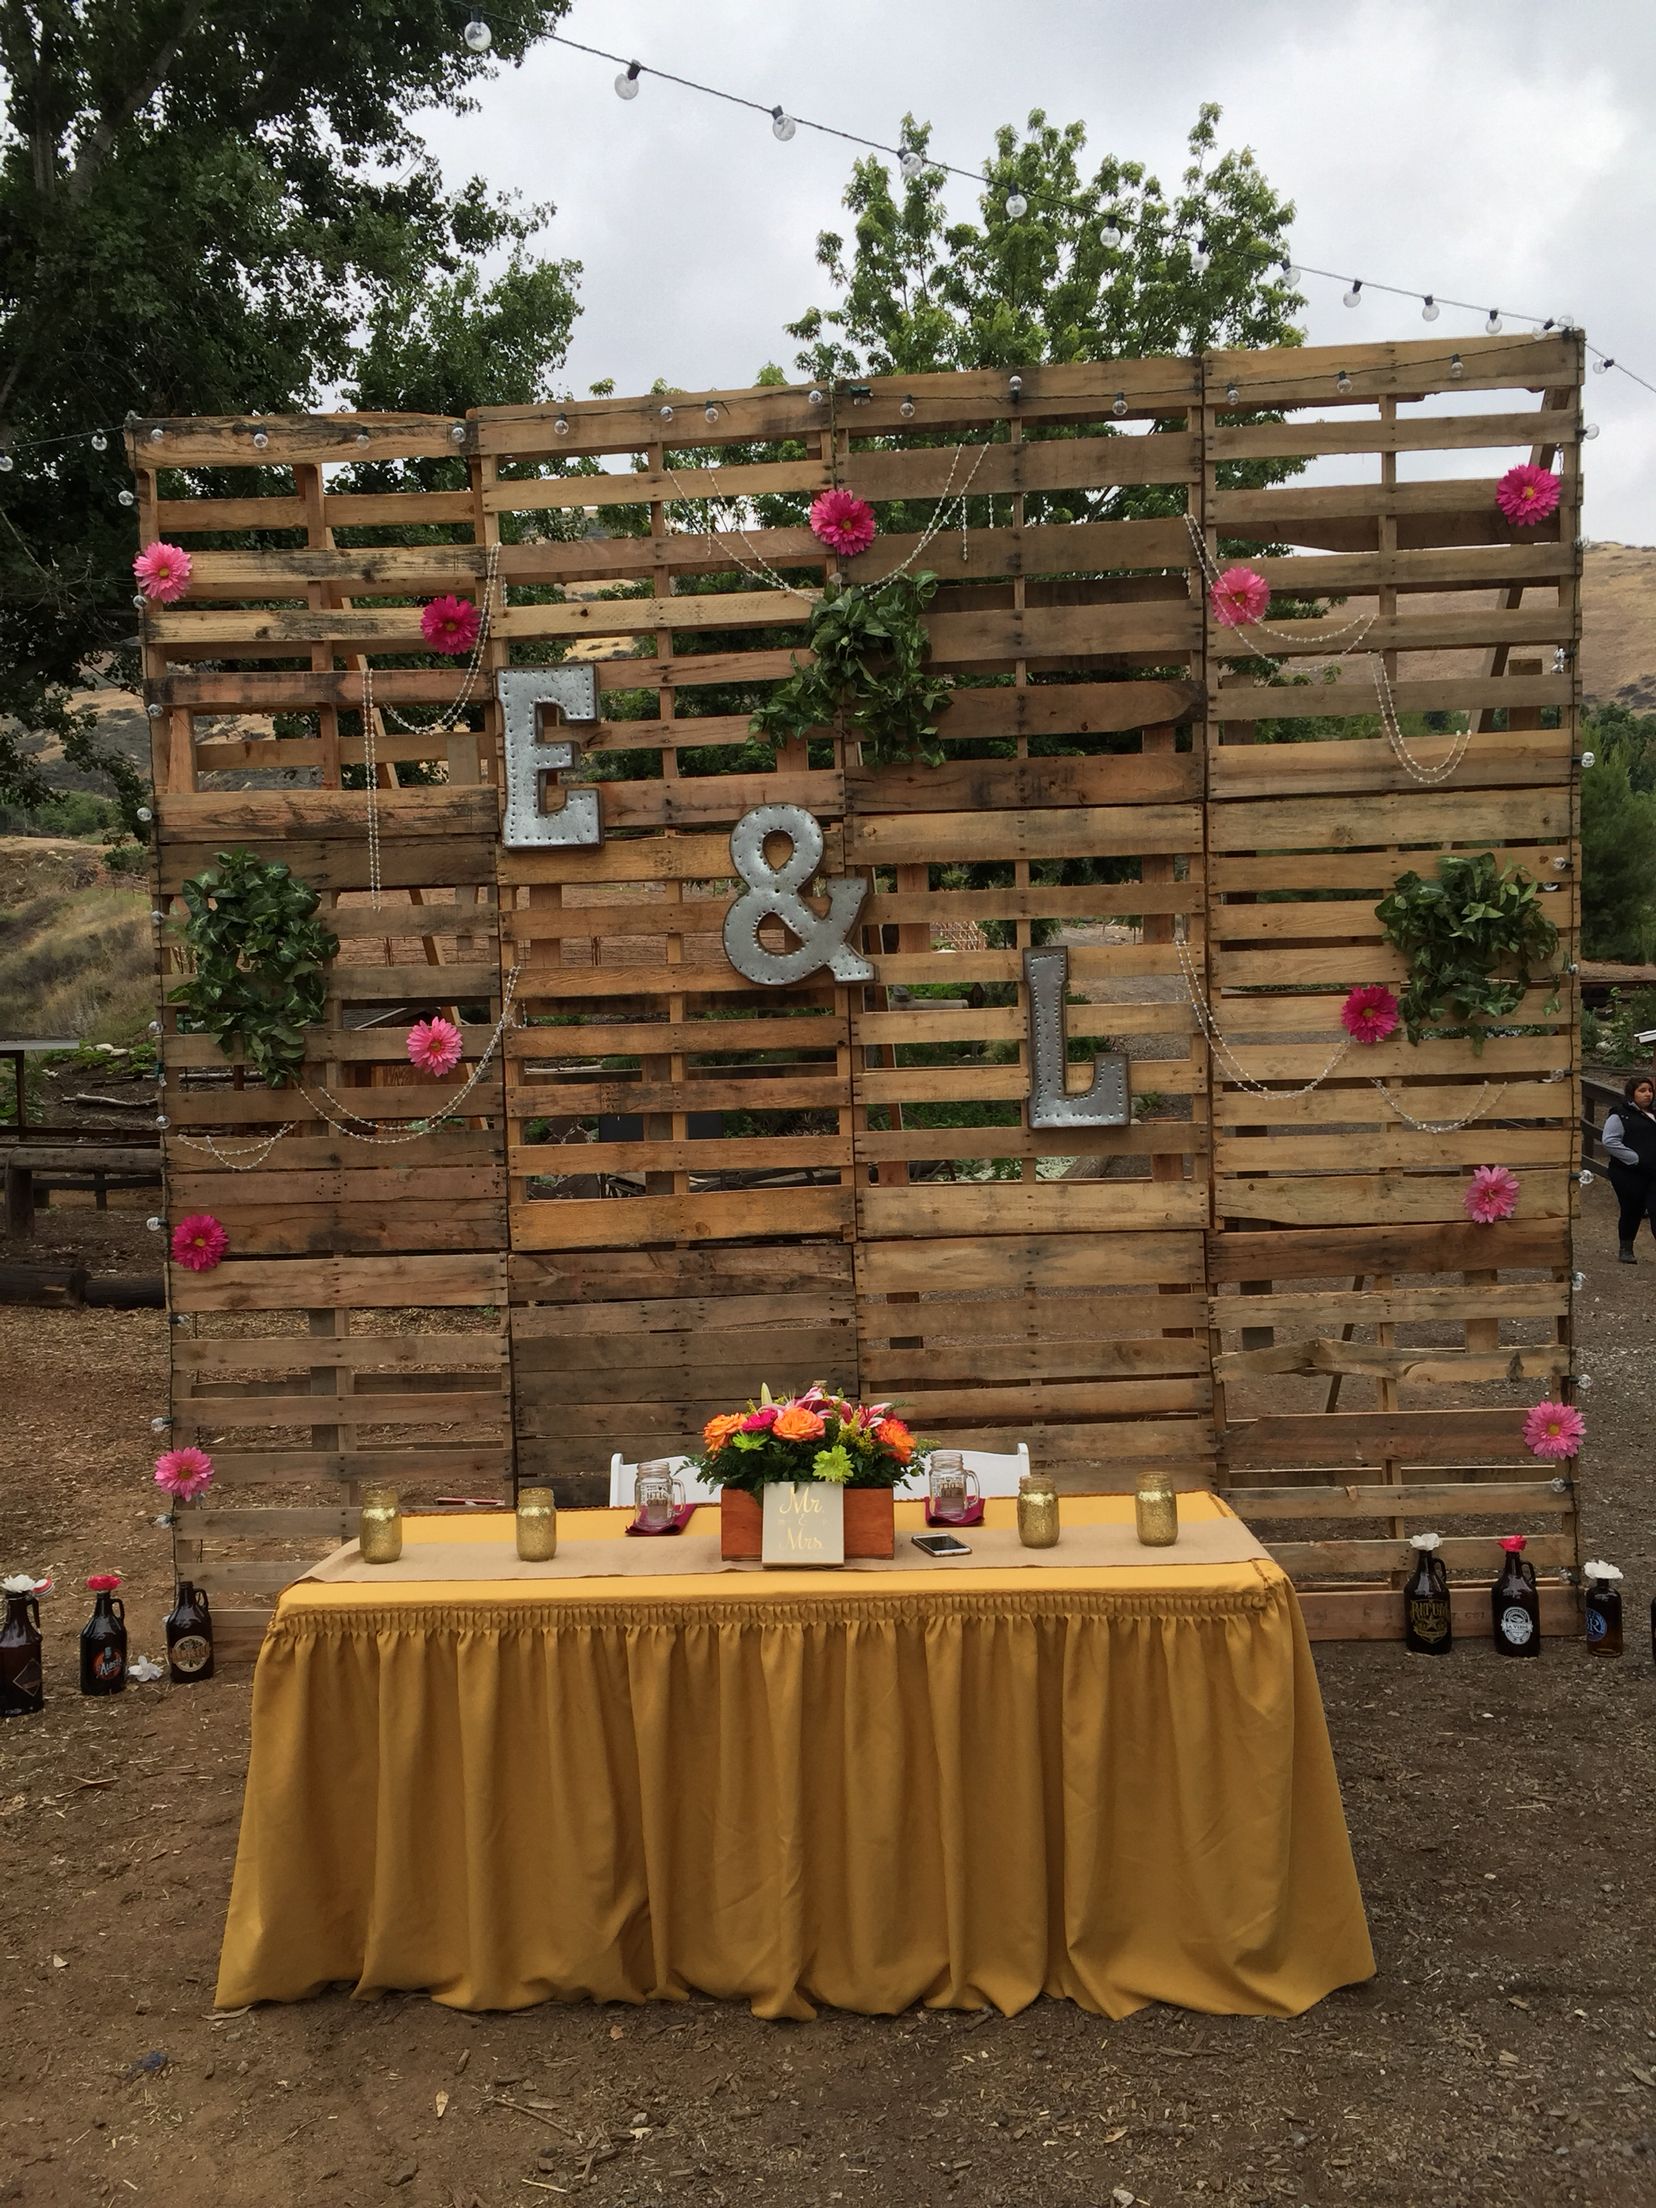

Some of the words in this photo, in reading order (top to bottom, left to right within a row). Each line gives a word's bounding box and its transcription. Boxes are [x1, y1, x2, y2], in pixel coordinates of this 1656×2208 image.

[497, 663, 604, 849] E
[723, 802, 877, 986] &
[1022, 946, 1131, 1129] L
[779, 1487, 822, 1514] Mr
[783, 1528, 822, 1550] Mrs
